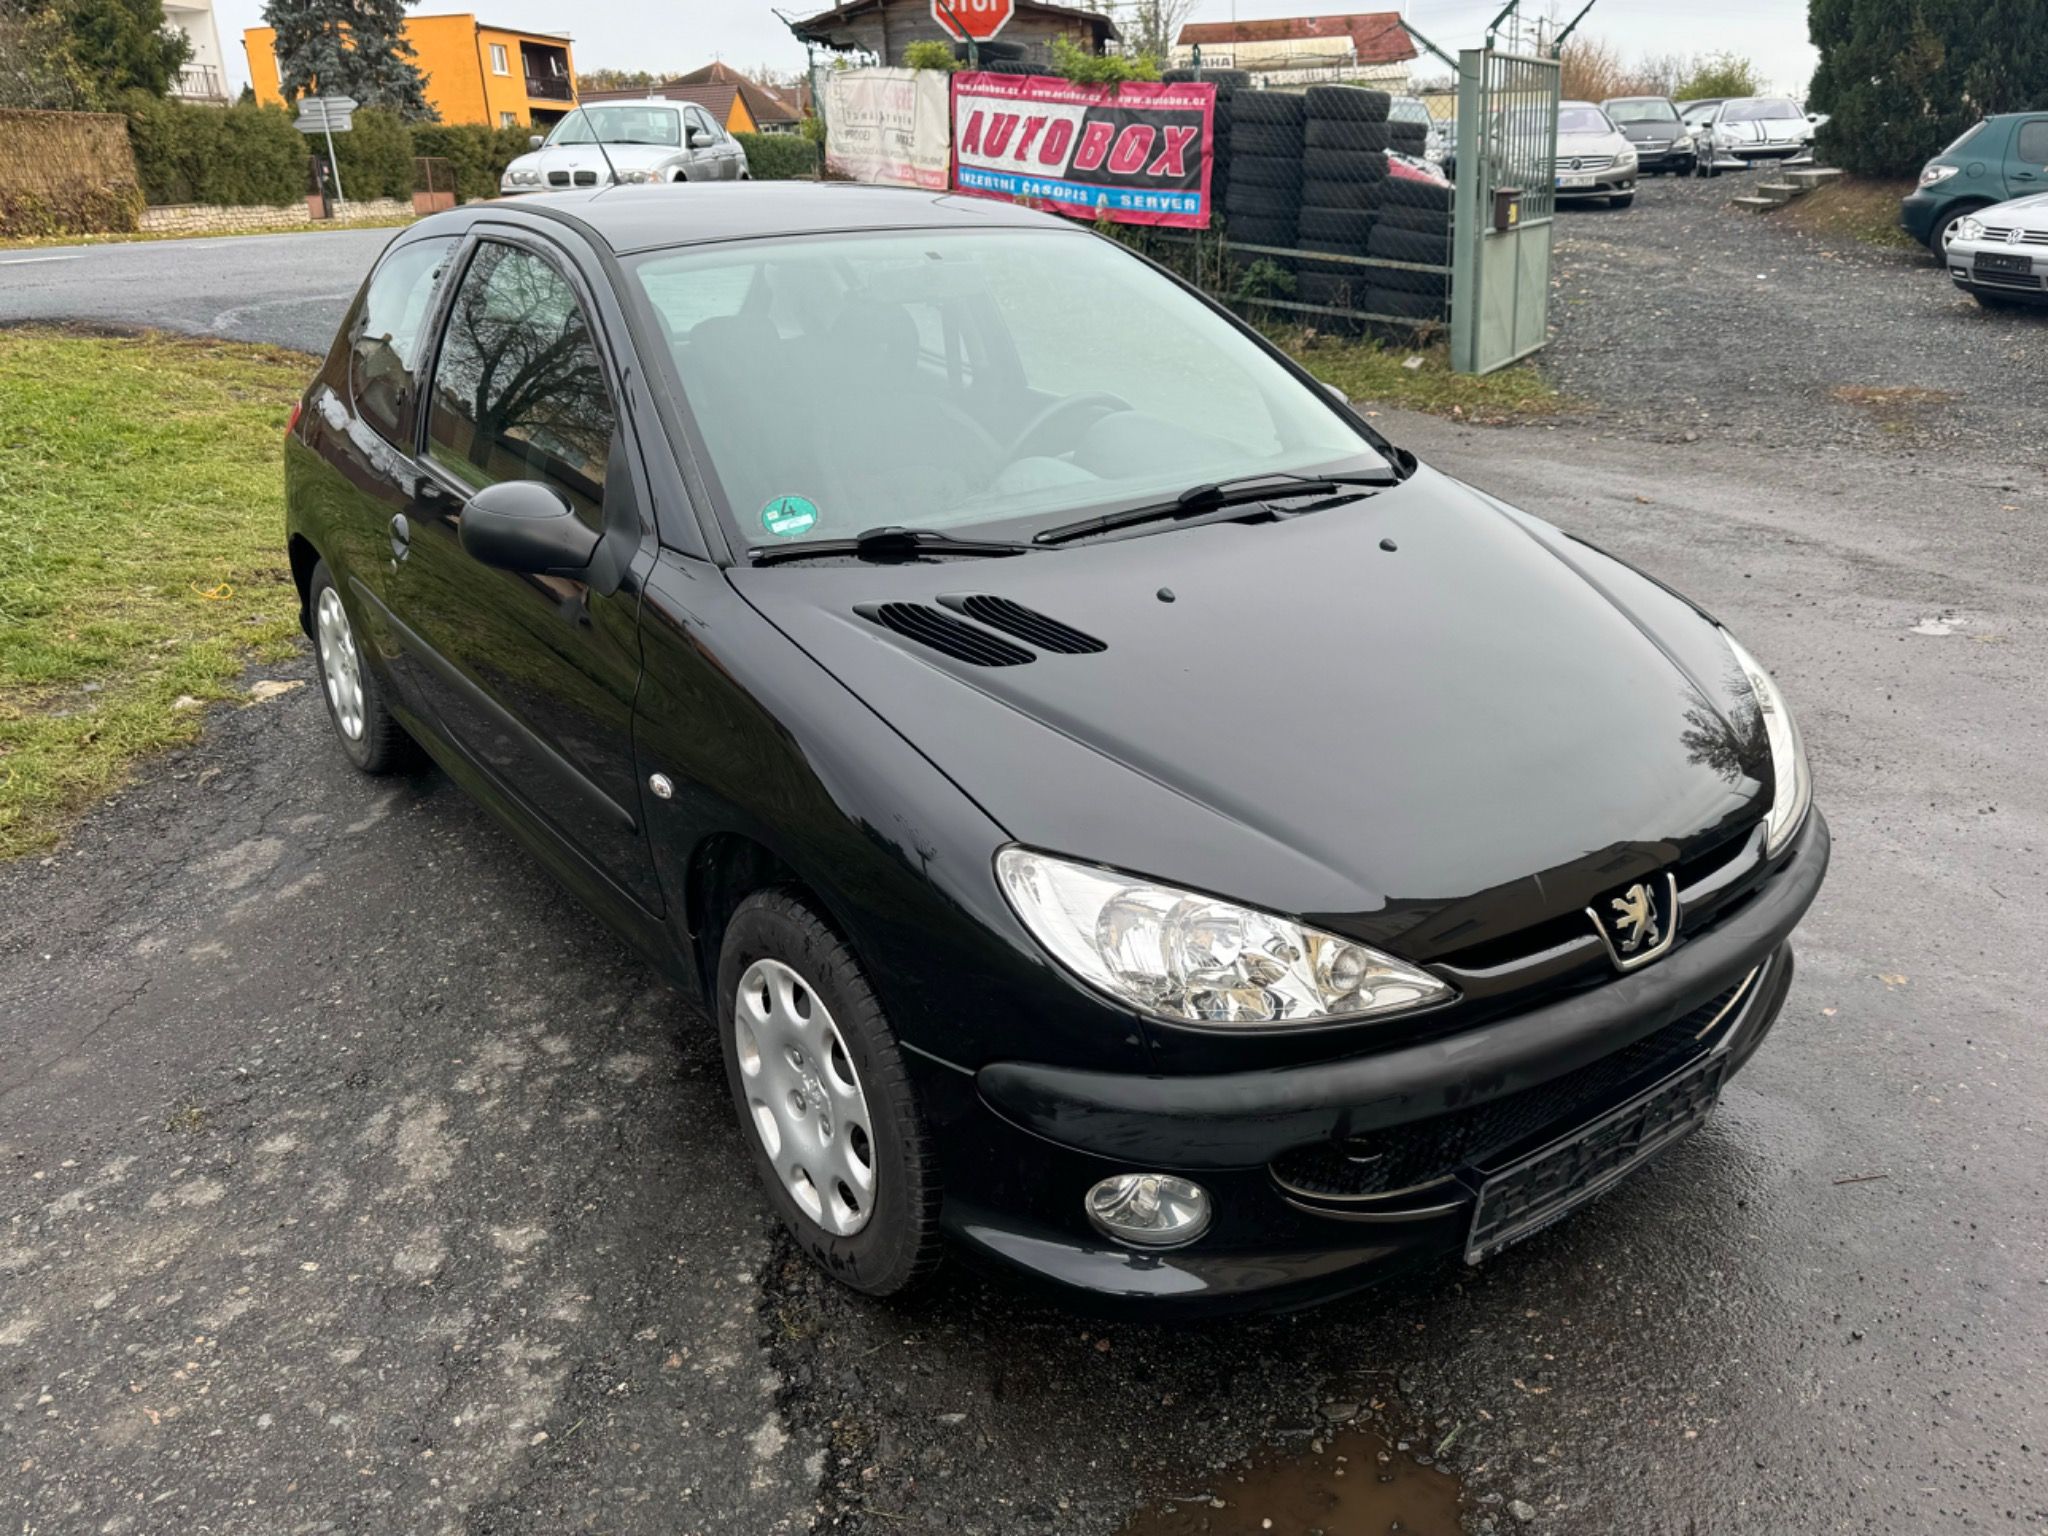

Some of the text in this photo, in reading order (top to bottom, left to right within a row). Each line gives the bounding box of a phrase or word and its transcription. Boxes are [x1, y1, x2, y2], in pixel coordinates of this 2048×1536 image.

[1179, 57, 1231, 69] PAHA
[961, 110, 1198, 177] AUTOBOX
[1022, 179, 1088, 202] ČASOPIS
[1121, 194, 1195, 211] SERVER
